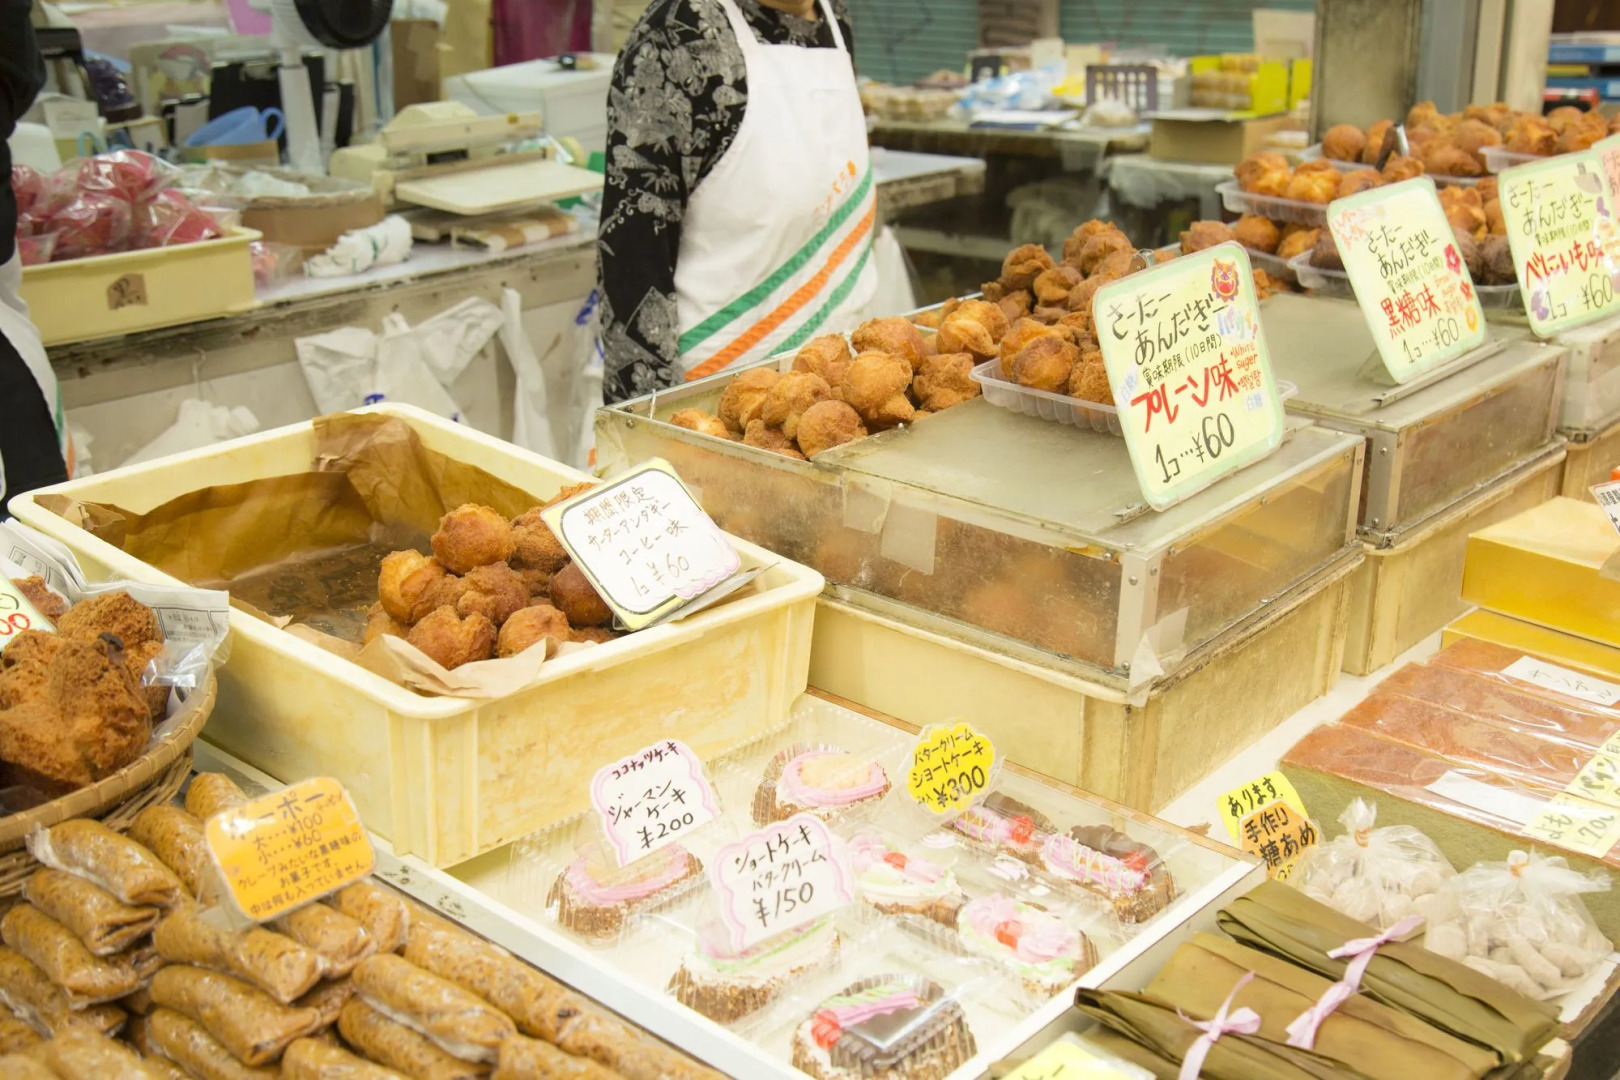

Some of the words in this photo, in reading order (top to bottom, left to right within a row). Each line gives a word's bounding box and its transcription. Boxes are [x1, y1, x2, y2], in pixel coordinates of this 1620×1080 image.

[1523, 192, 1594, 235] あんだぎー
[1378, 229, 1440, 279] あんだぎー
[1108, 293, 1171, 340] さーたー
[1135, 293, 1229, 365] あんだぎー
[1381, 283, 1442, 339] 黒糖味
[1131, 353, 1239, 433] プレーン味
[584, 486, 654, 525] 期間限定
[588, 500, 671, 550] サーターアンダギー
[620, 518, 689, 565] コーヒー味
[612, 741, 680, 780] ココナッツケーキ
[913, 741, 984, 788] ショートケーキ
[914, 728, 973, 766] バタークリーム
[608, 780, 672, 826] ジャーマン
[647, 788, 686, 819] ケーキ
[933, 765, 985, 807] ¥300
[637, 812, 694, 850] ¥200
[1245, 807, 1289, 843] 手作り
[1249, 821, 1315, 871] 糖あめ
[735, 825, 811, 874] ショートケーキ
[753, 850, 827, 891] バタークリーム
[753, 881, 814, 928] ¥150
